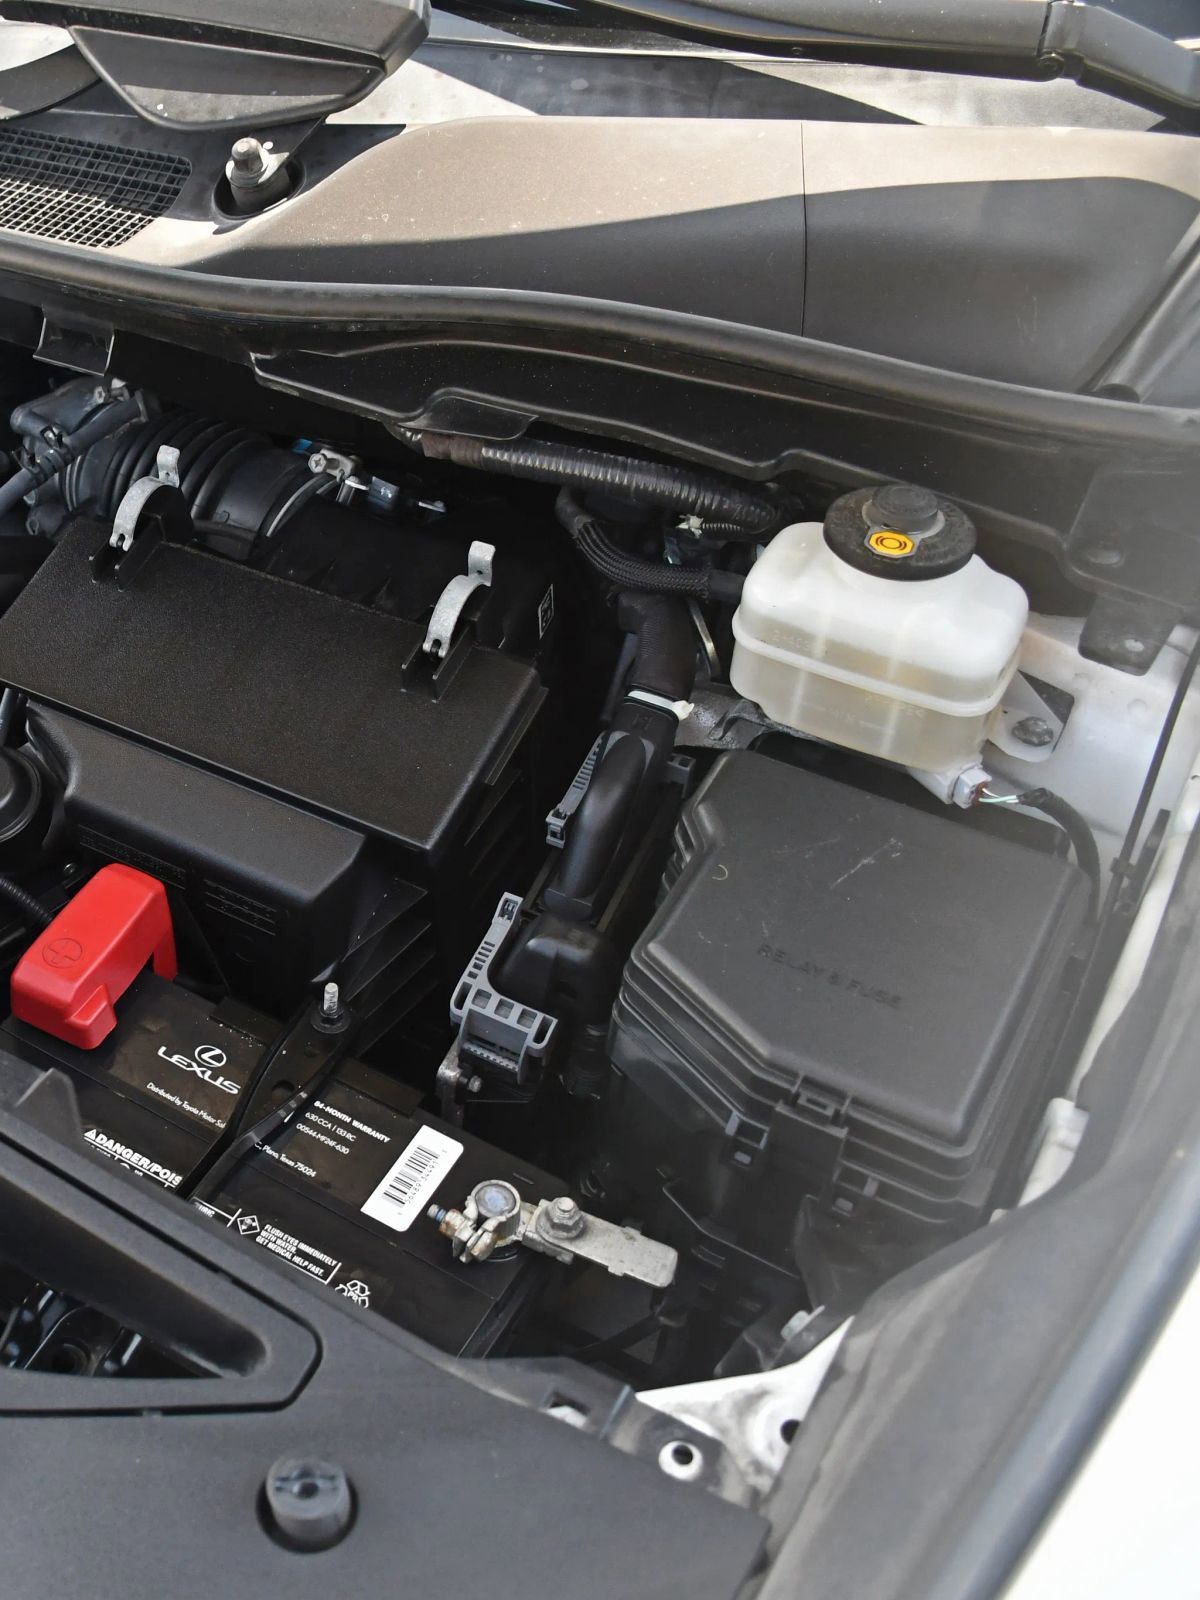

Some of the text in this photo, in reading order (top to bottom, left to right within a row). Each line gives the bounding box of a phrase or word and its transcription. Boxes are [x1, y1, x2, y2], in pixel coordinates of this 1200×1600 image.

[157, 1046, 241, 1095] LEXUS
[147, 1082, 177, 1102] Distributed
[182, 1101, 199, 1114] Toyota
[199, 1110, 216, 1123] Motor
[305, 1112, 318, 1123] 630
[317, 1118, 332, 1129] CCA
[352, 1120, 391, 1143] WARRANTY
[280, 1153, 295, 1167] Texas
[294, 1162, 316, 1177] 75024
[260, 1229, 277, 1242] WITH
[264, 1224, 338, 1267] FLUSH EYES IMMEDIATELY
[255, 1235, 269, 1246] GET
[267, 1242, 293, 1260] MEDICAL
[292, 1255, 309, 1267] HELP
